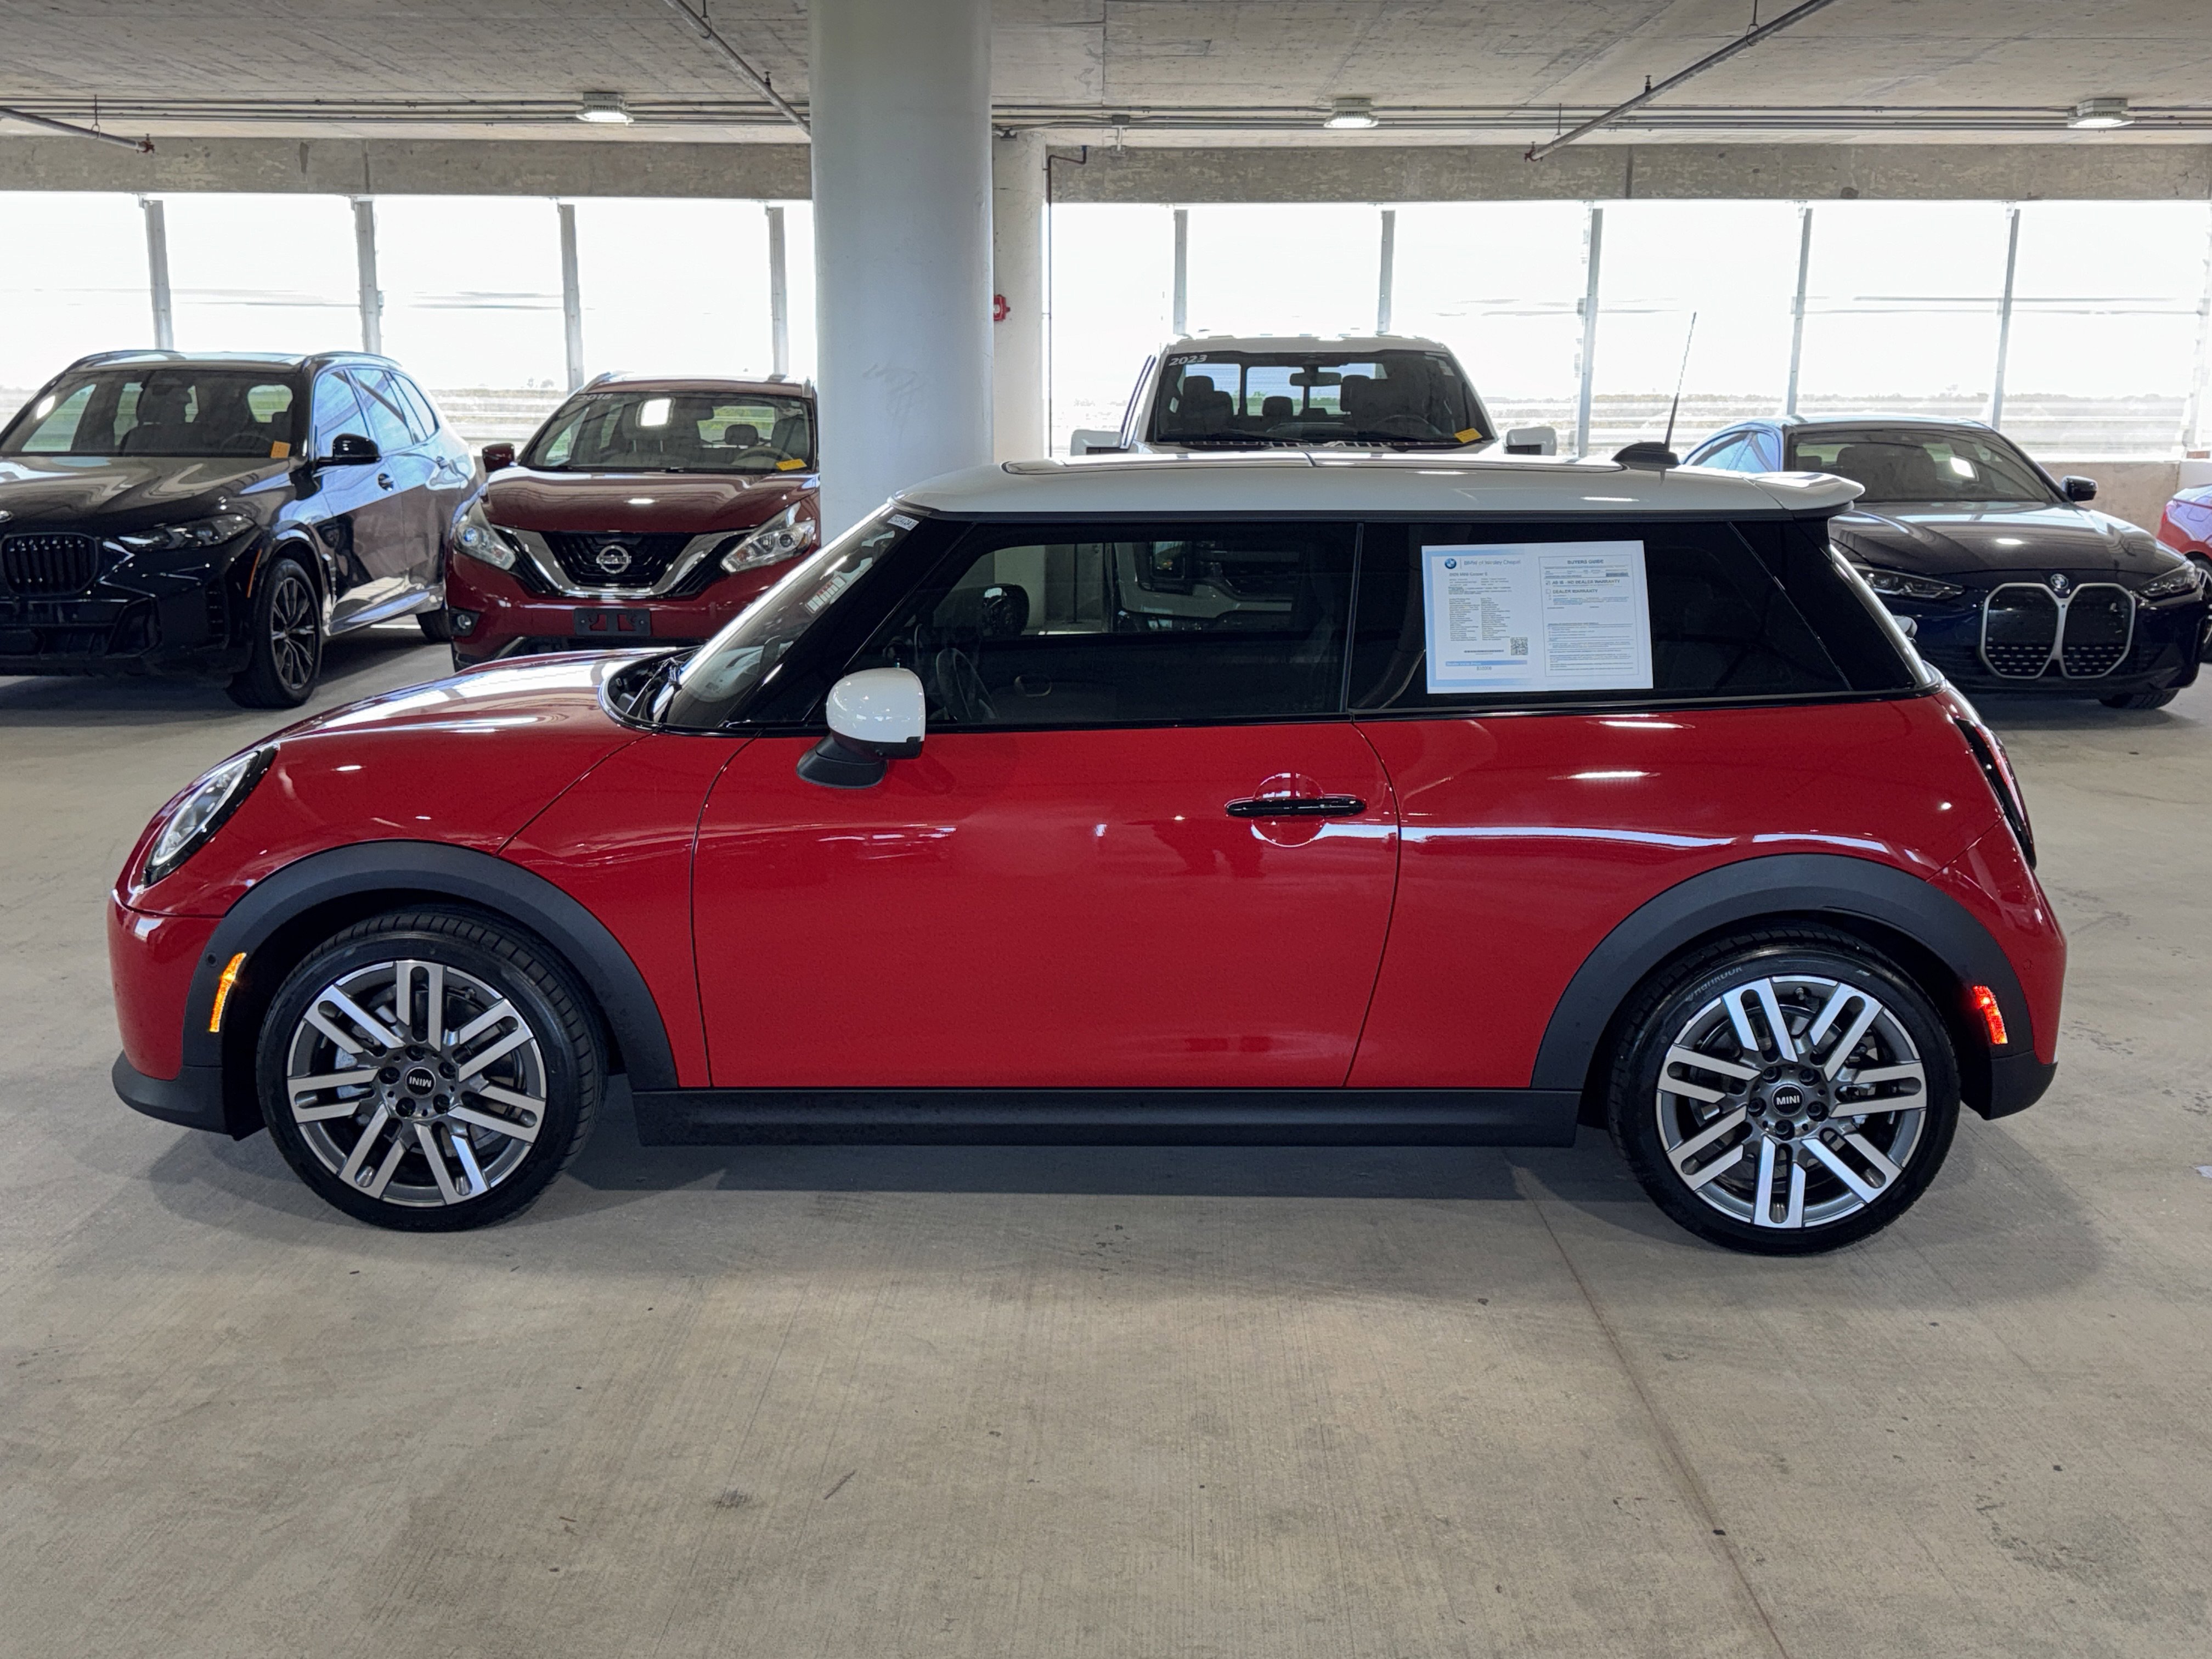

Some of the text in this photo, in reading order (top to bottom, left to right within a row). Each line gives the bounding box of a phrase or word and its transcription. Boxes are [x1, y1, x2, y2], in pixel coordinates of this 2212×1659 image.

[1169, 354, 1207, 366] 2023
[409, 1076, 432, 1087] MINI
[1776, 1095, 1800, 1105] MINI
